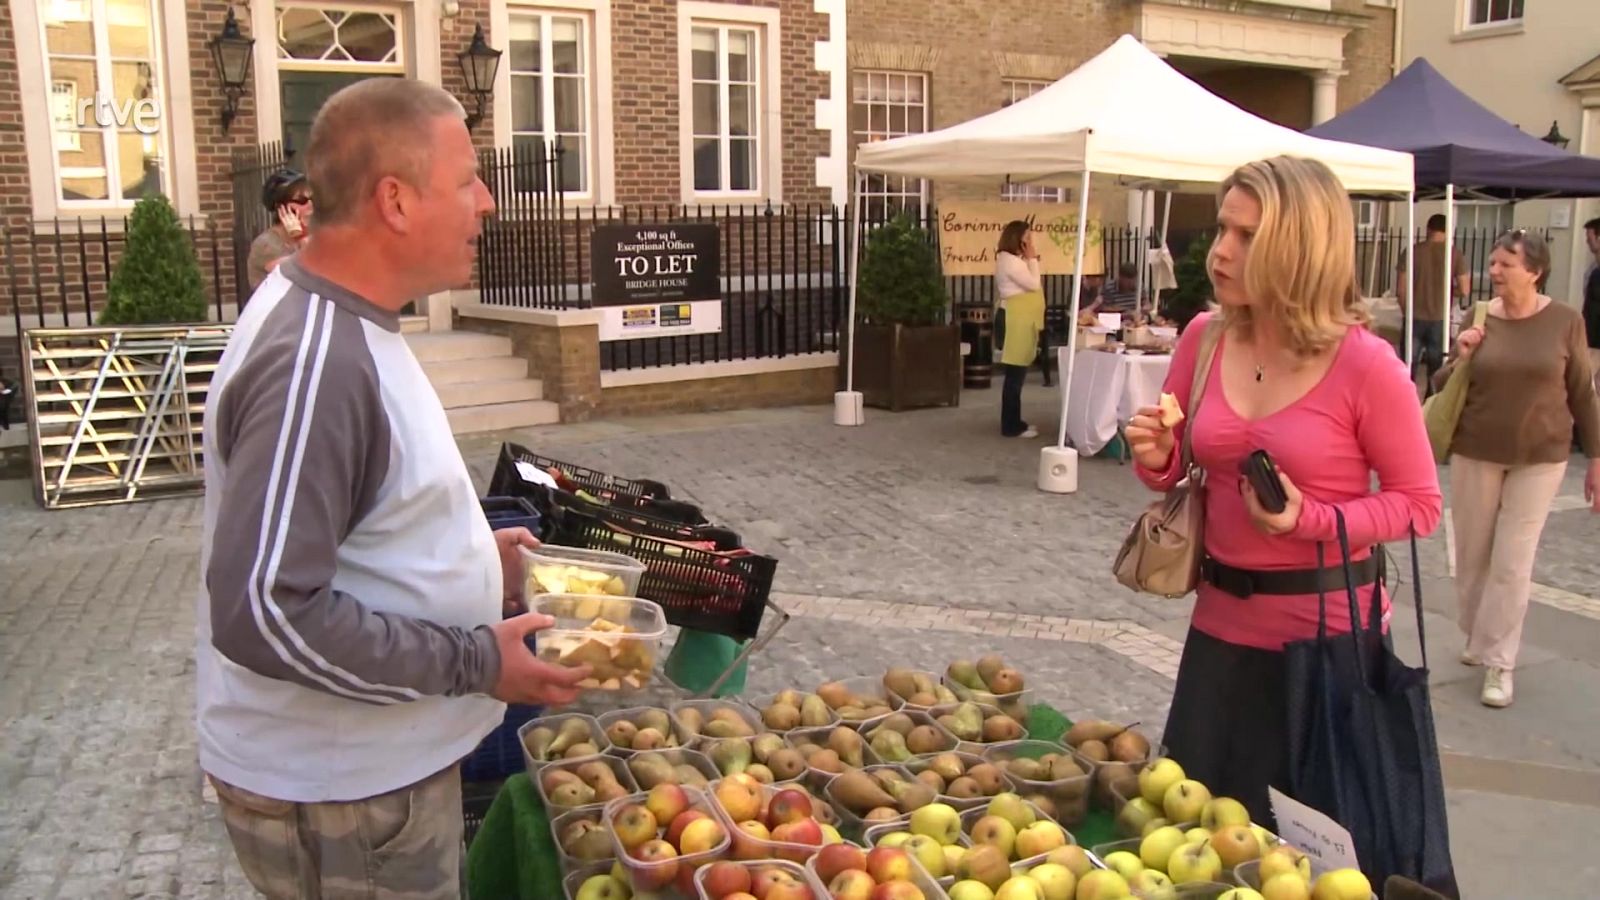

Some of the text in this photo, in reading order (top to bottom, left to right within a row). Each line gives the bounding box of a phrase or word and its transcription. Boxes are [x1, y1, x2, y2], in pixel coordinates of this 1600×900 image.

[636, 230, 676, 242] 4,100 sq ft
[617, 240, 694, 253] Exceptional Offices
[944, 246, 988, 263] French
[615, 255, 697, 276] TO LET
[625, 278, 688, 289] BRIDGE HOUSE
